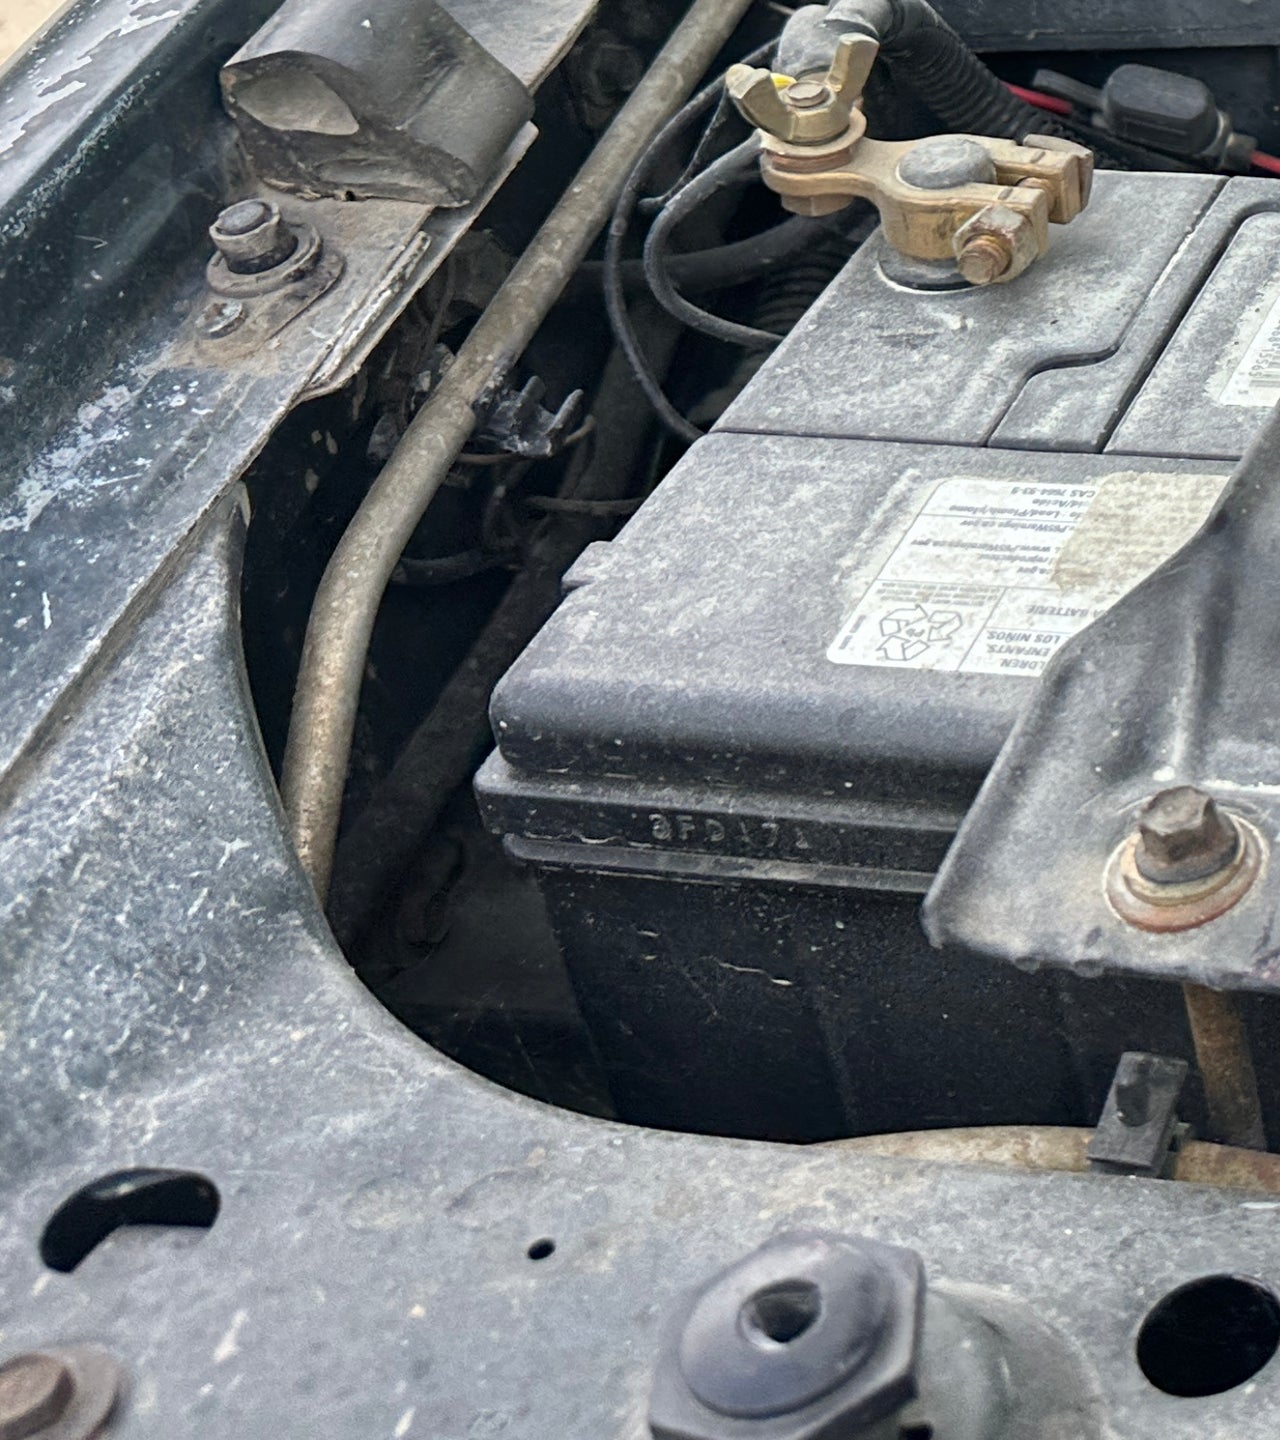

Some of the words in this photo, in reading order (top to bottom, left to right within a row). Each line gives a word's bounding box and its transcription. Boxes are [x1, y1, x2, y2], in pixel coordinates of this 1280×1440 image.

[1070, 490, 1096, 499] CAS
[986, 630, 1033, 643] NIÑOS.
[1035, 634, 1060, 644] LOS
[1000, 658, 1046, 670] LDREN.
